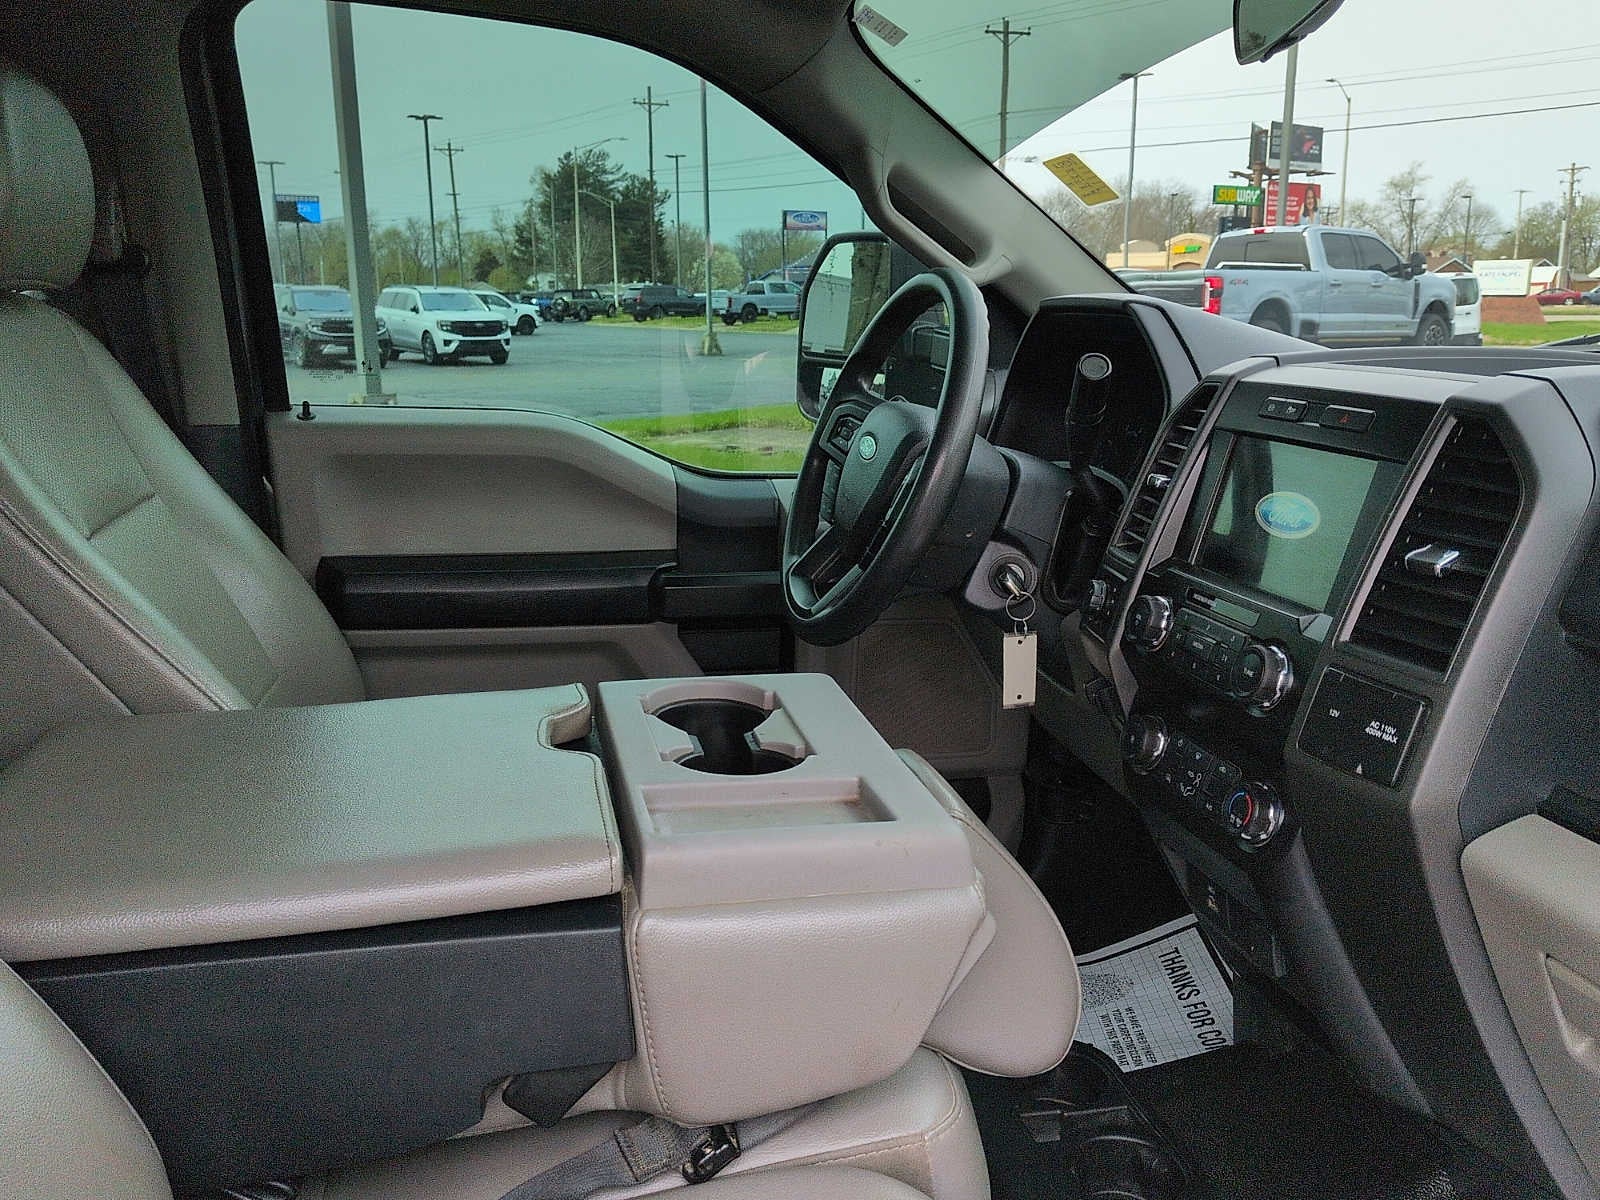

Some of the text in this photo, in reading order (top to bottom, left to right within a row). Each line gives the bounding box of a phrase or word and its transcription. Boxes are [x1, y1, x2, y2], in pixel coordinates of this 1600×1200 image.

[1217, 188, 1260, 202] SUBWAY
[1329, 708, 1341, 718] 12V
[1369, 720, 1381, 730] AC
[1382, 732, 1398, 744] MAX
[1158, 947, 1200, 1001] THANKS
[1183, 1001, 1216, 1029] FOR
[1117, 1054, 1129, 1067] MAT
